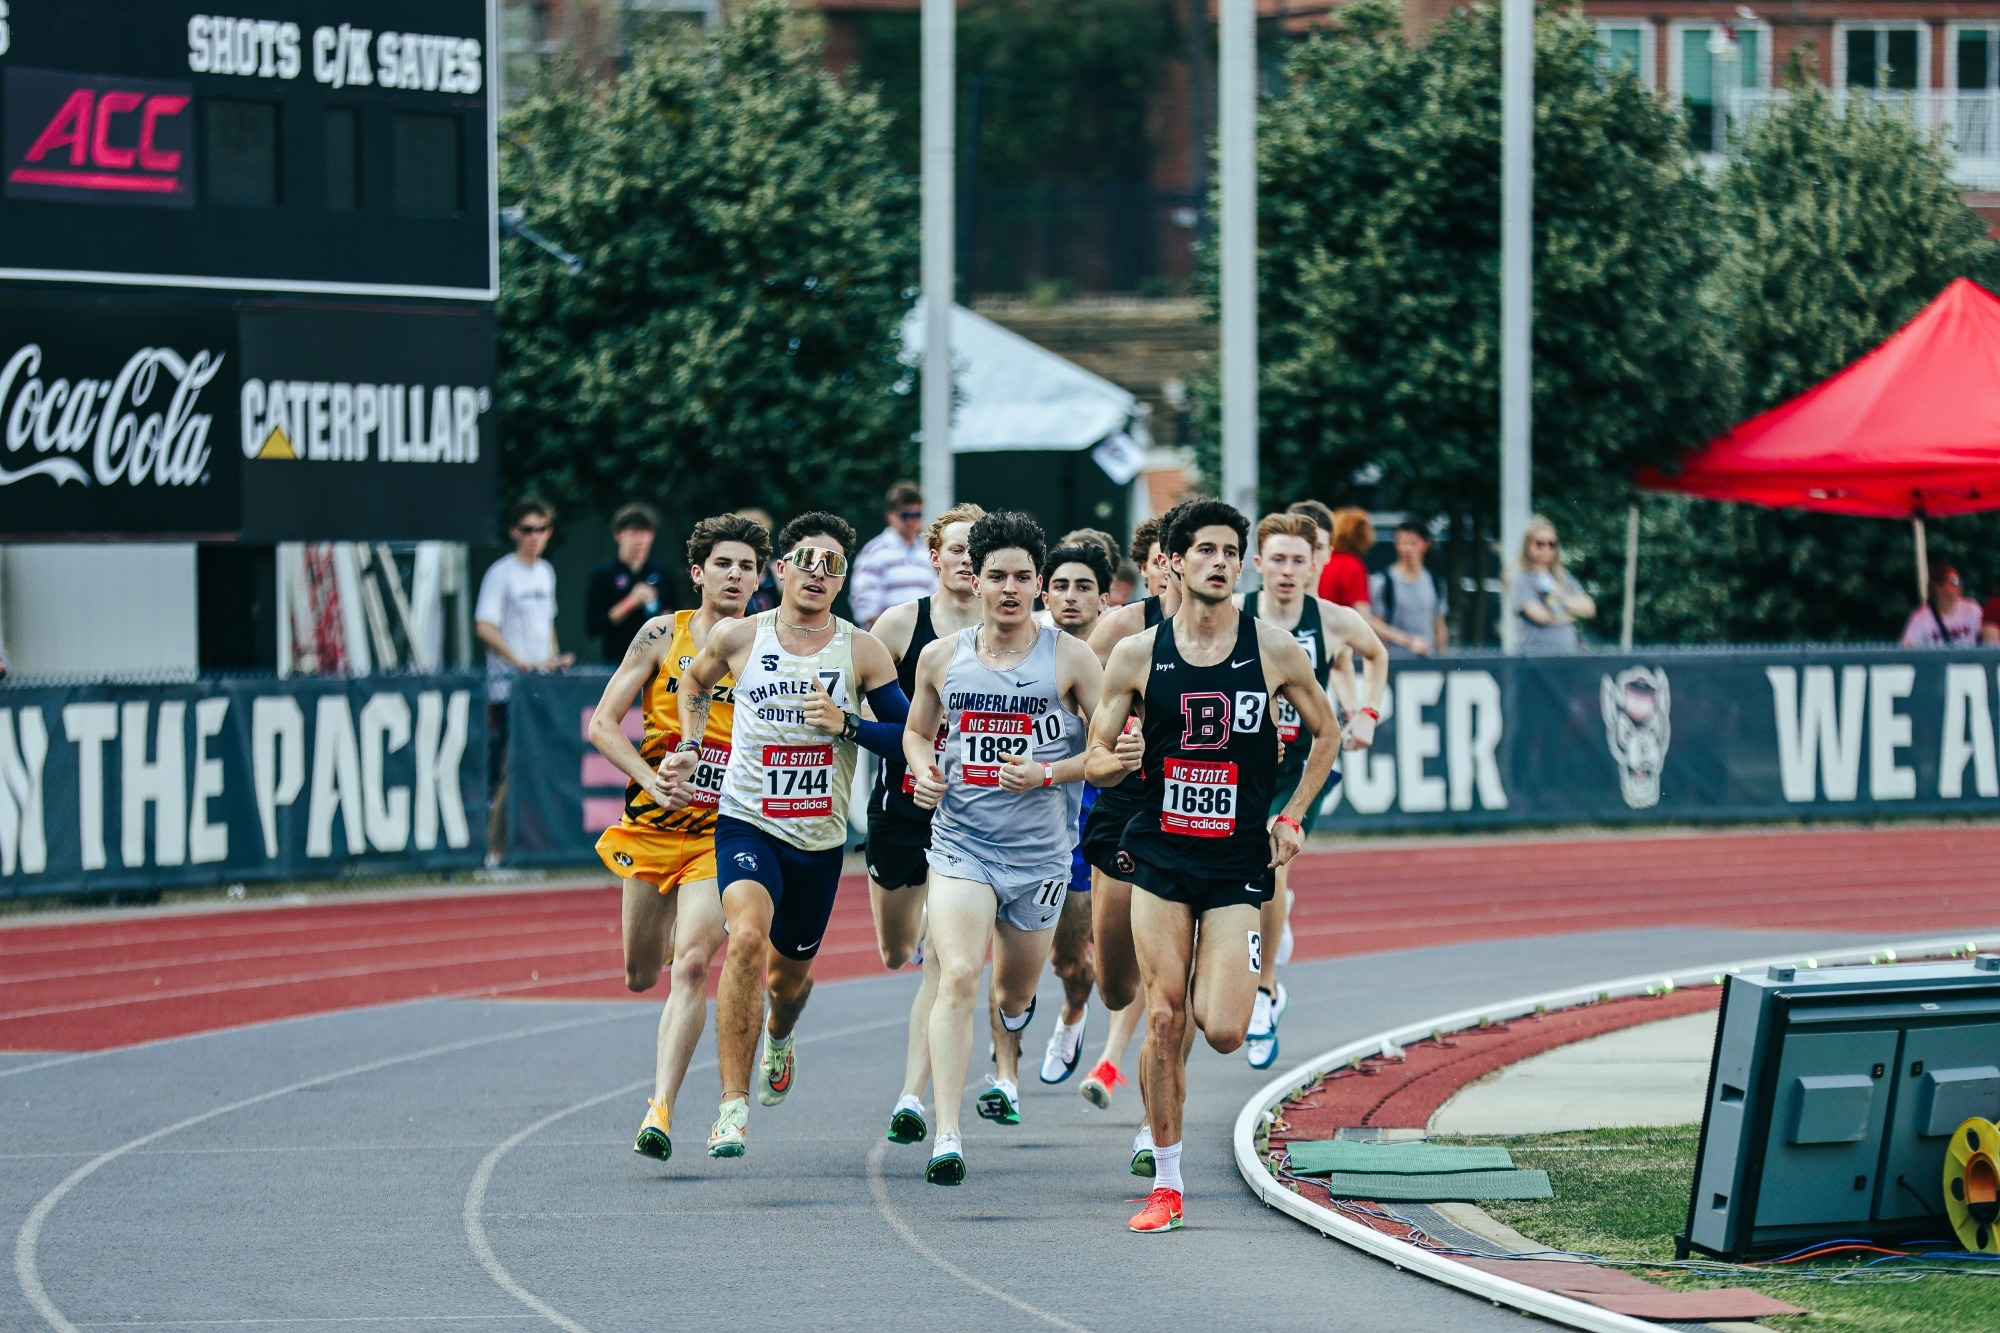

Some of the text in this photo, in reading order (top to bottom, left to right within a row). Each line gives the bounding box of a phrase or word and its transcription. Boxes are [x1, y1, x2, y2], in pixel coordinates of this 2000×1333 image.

[187, 14, 481, 94] SHOTS C/K SAVES
[24, 89, 191, 171] ACC
[750, 680, 817, 703] CHARLES
[819, 672, 840, 697] 7
[757, 708, 805, 724] SOUTH
[949, 692, 1049, 715] CUMBERLANDS
[1238, 695, 1260, 730] 3
[968, 719, 1024, 732] NC STATE
[1032, 714, 1060, 745] 10
[1181, 692, 1231, 750] B
[1765, 663, 2000, 802] WE A
[966, 736, 1028, 764] 1882
[1319, 670, 1508, 815] CER
[700, 747, 729, 765] TATE
[770, 752, 826, 766] NC STATE
[62, 700, 231, 871] THE
[252, 691, 471, 859] PACK
[688, 764, 726, 791] 95
[767, 769, 828, 795] 1744
[1172, 766, 1229, 783] NC STATE
[792, 799, 828, 811] adidas
[1170, 784, 1231, 815] 1636
[1190, 818, 1230, 831] adidas
[1040, 881, 1064, 906] 10
[1251, 934, 1260, 970] 3
